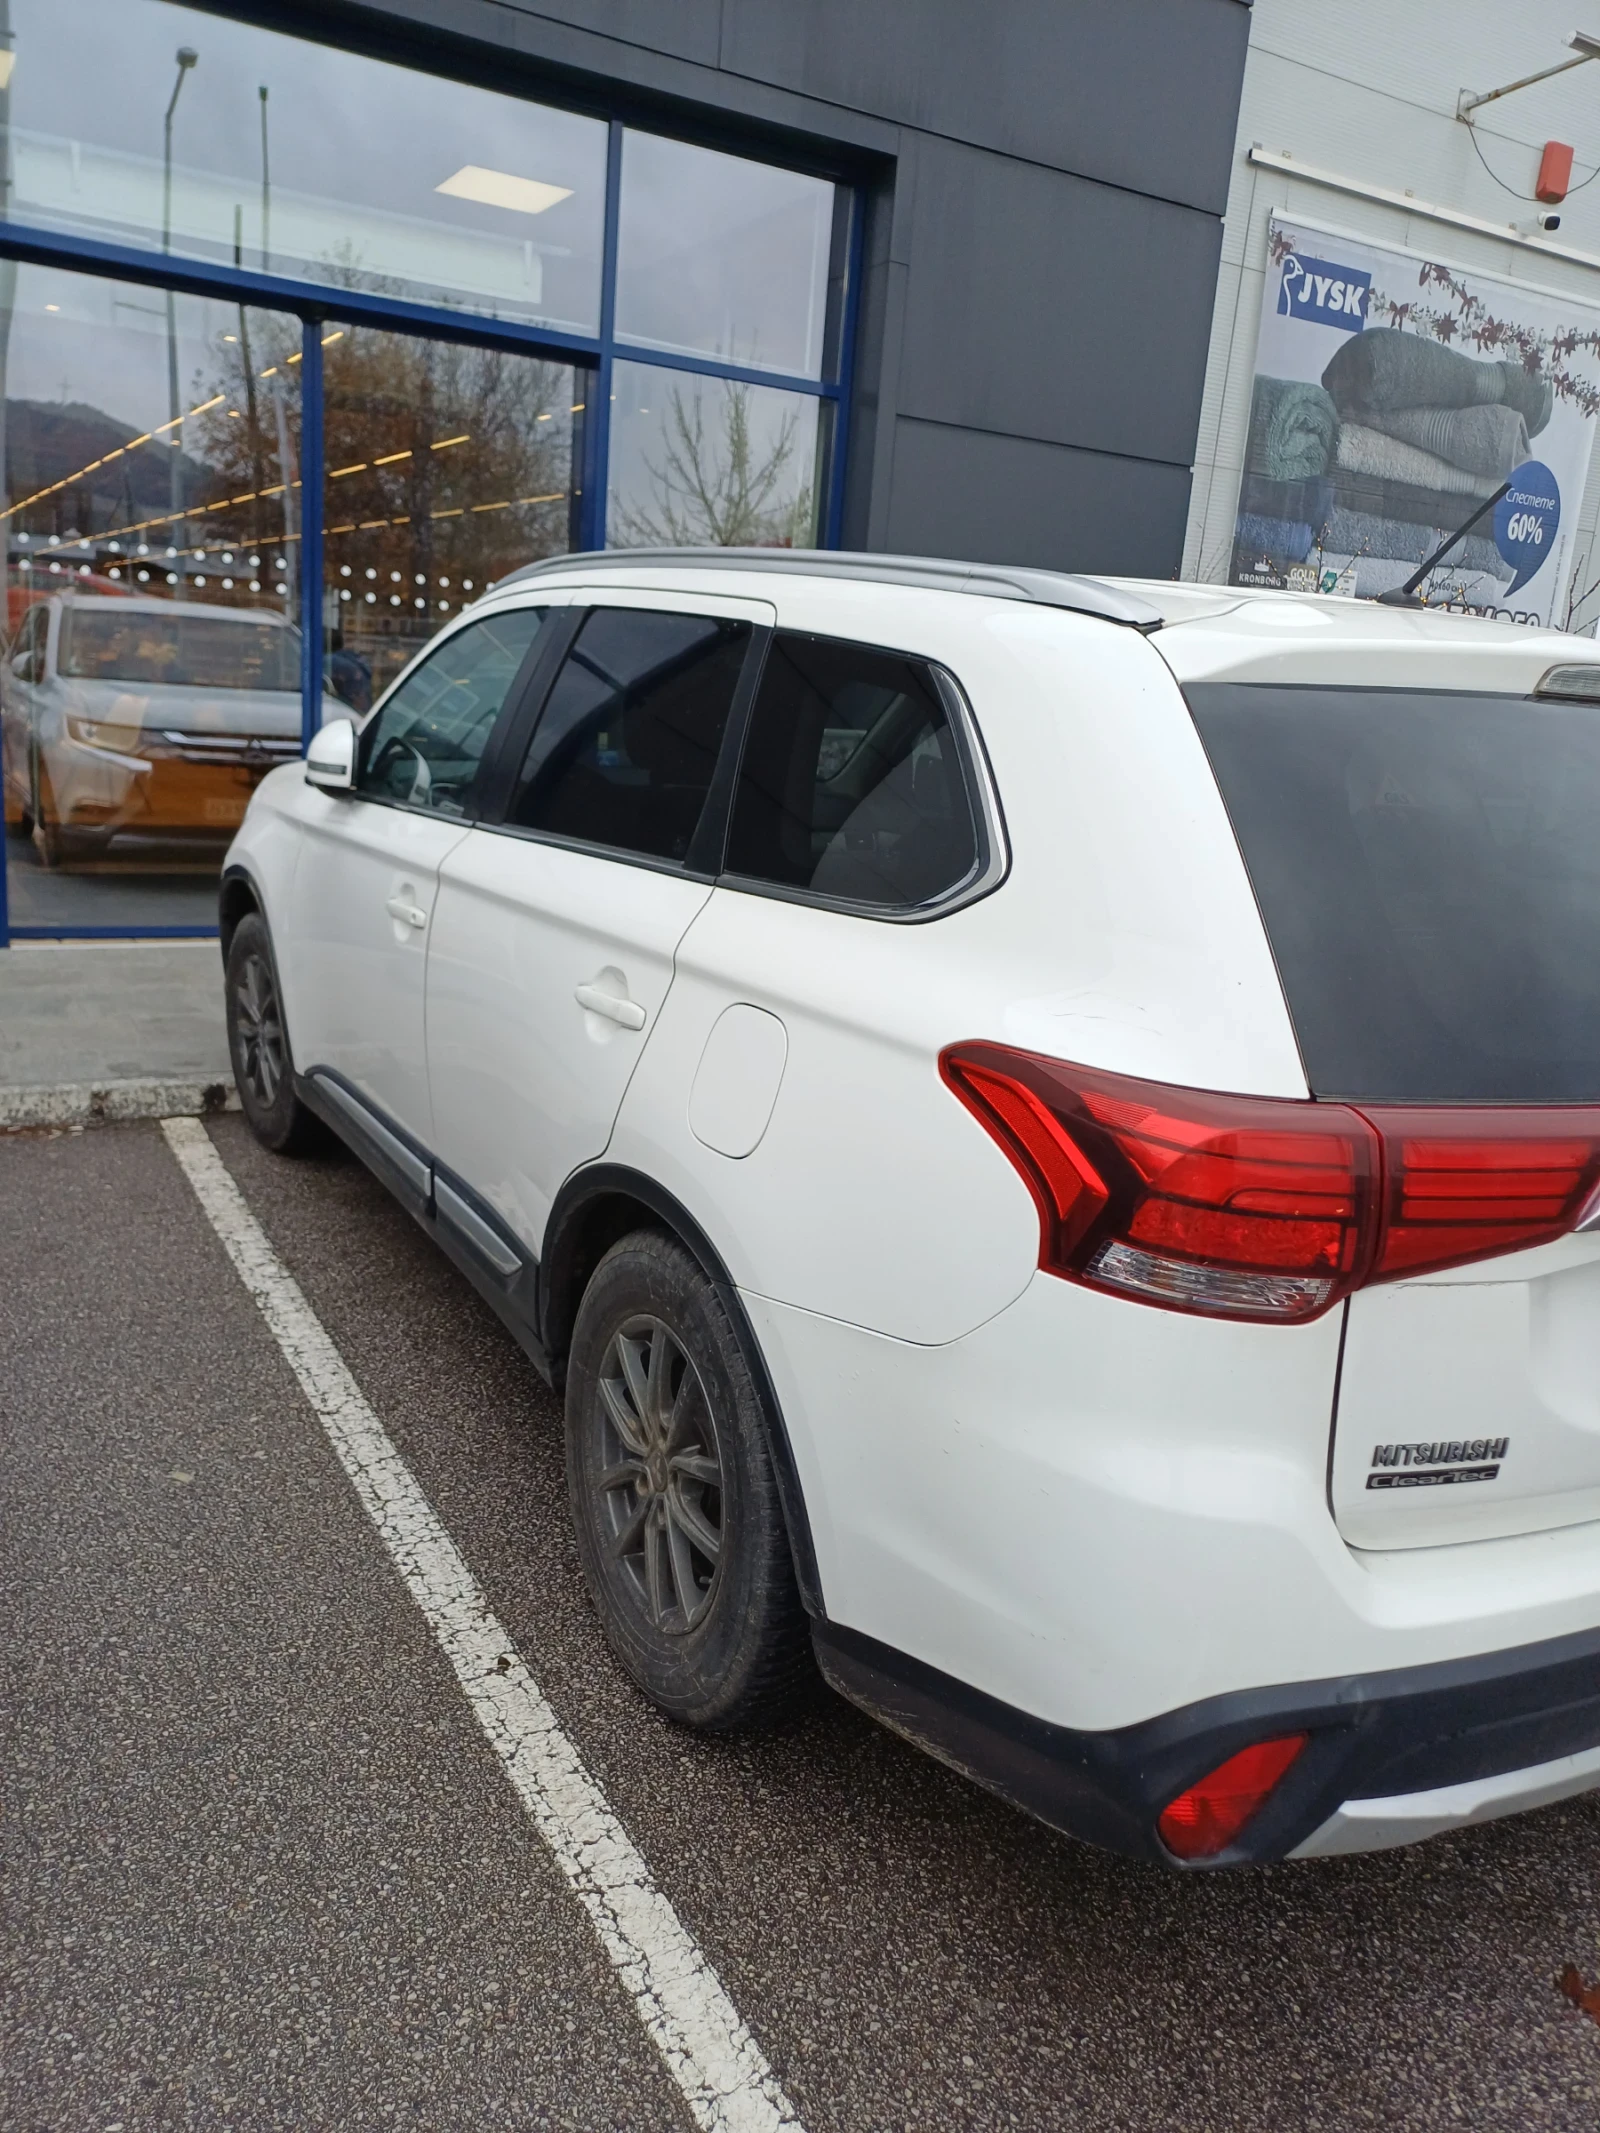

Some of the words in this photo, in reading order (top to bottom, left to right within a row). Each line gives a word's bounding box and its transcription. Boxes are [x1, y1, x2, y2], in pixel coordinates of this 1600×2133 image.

[1298, 273, 1365, 317] JYSK
[1505, 488, 1555, 510] Спестете
[1507, 512, 1542, 545] 60%
[1239, 573, 1281, 586] KRONBORG
[1290, 567, 1315, 581] GOLD
[1371, 1437, 1510, 1467] MITSUBISHI
[1370, 1470, 1496, 1488] ClearTec
